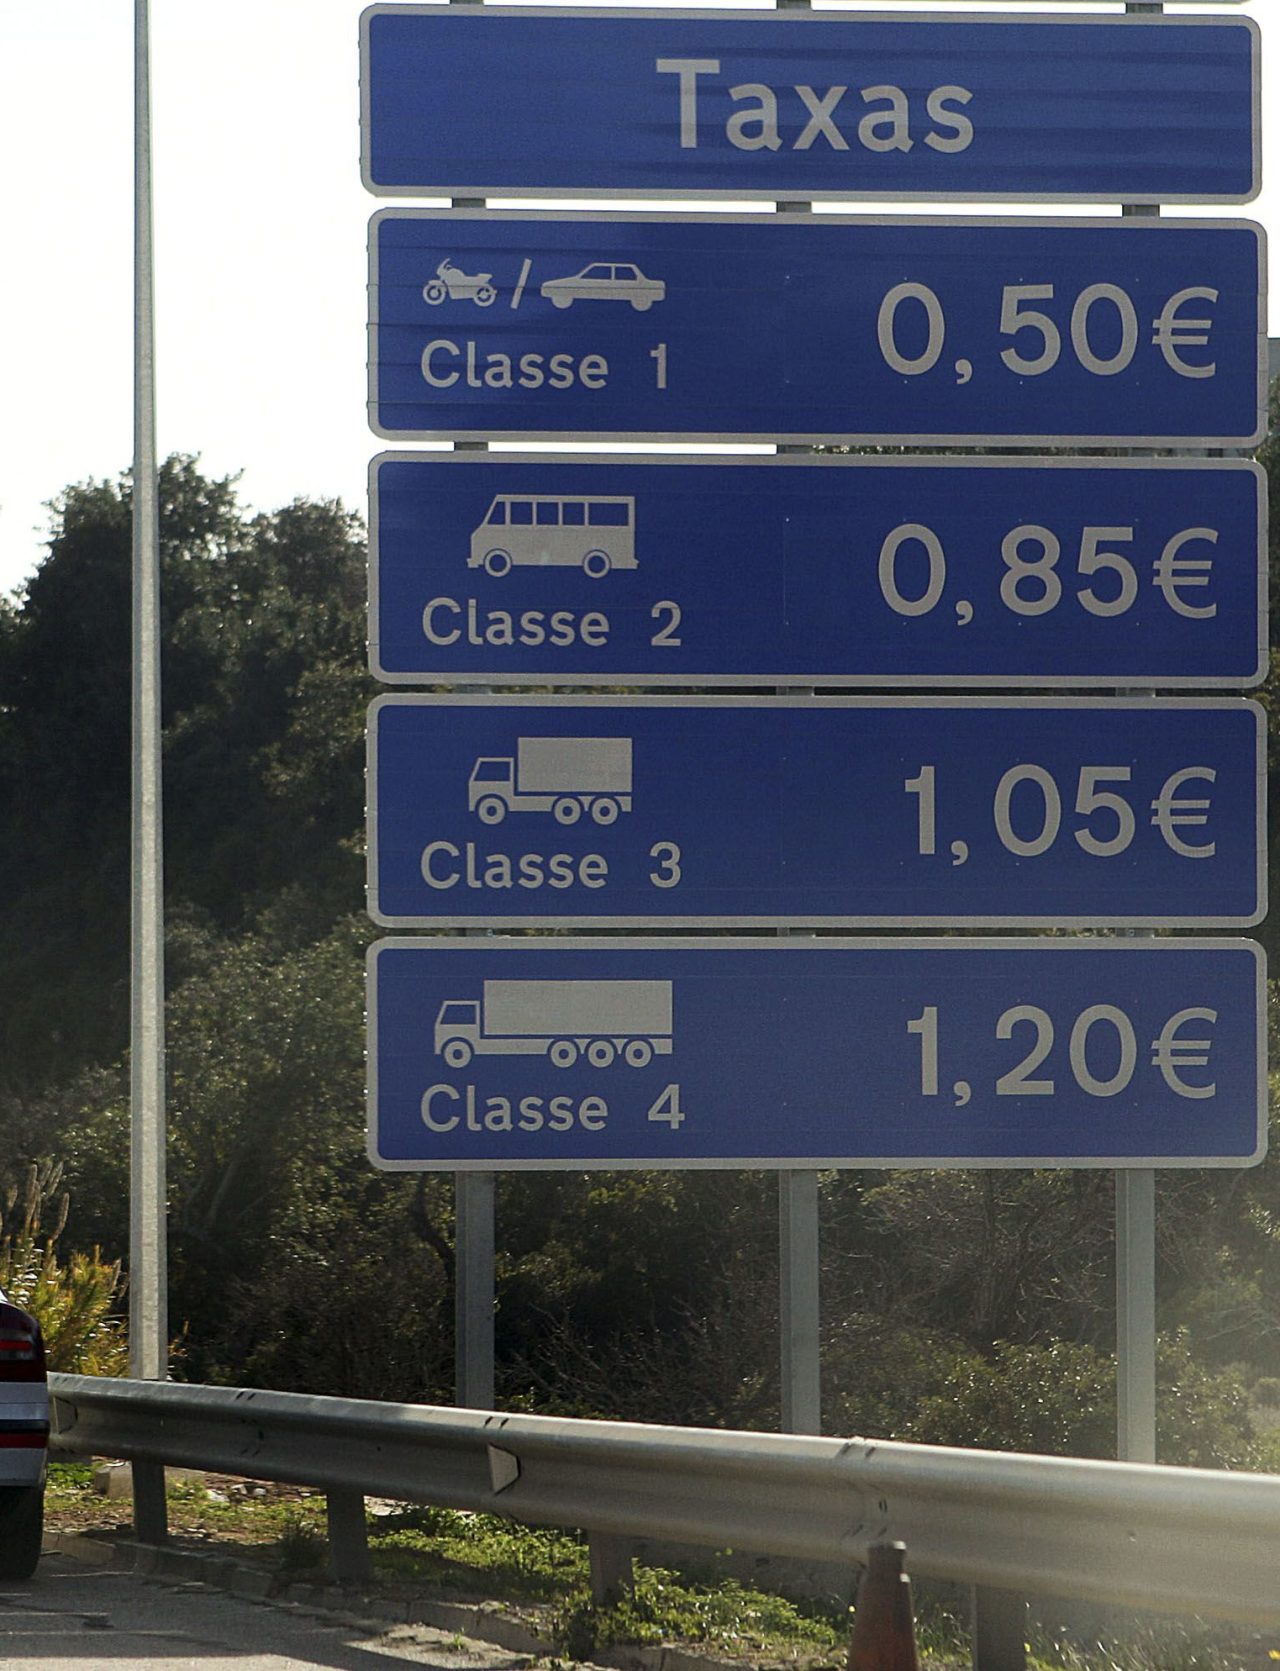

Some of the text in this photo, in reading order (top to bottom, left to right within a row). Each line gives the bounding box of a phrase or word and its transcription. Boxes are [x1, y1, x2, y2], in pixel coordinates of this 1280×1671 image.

[656, 58, 975, 154] Taxas
[421, 339, 668, 389] Classe 1
[877, 282, 1219, 385] 0,50€
[422, 597, 682, 646] Classe 2
[878, 523, 1219, 626] 0,85€
[904, 764, 1217, 866] 1,05€
[421, 840, 682, 889] Classe 3
[906, 1004, 1218, 1107] 1,20€
[421, 1083, 686, 1132] Classe 4
